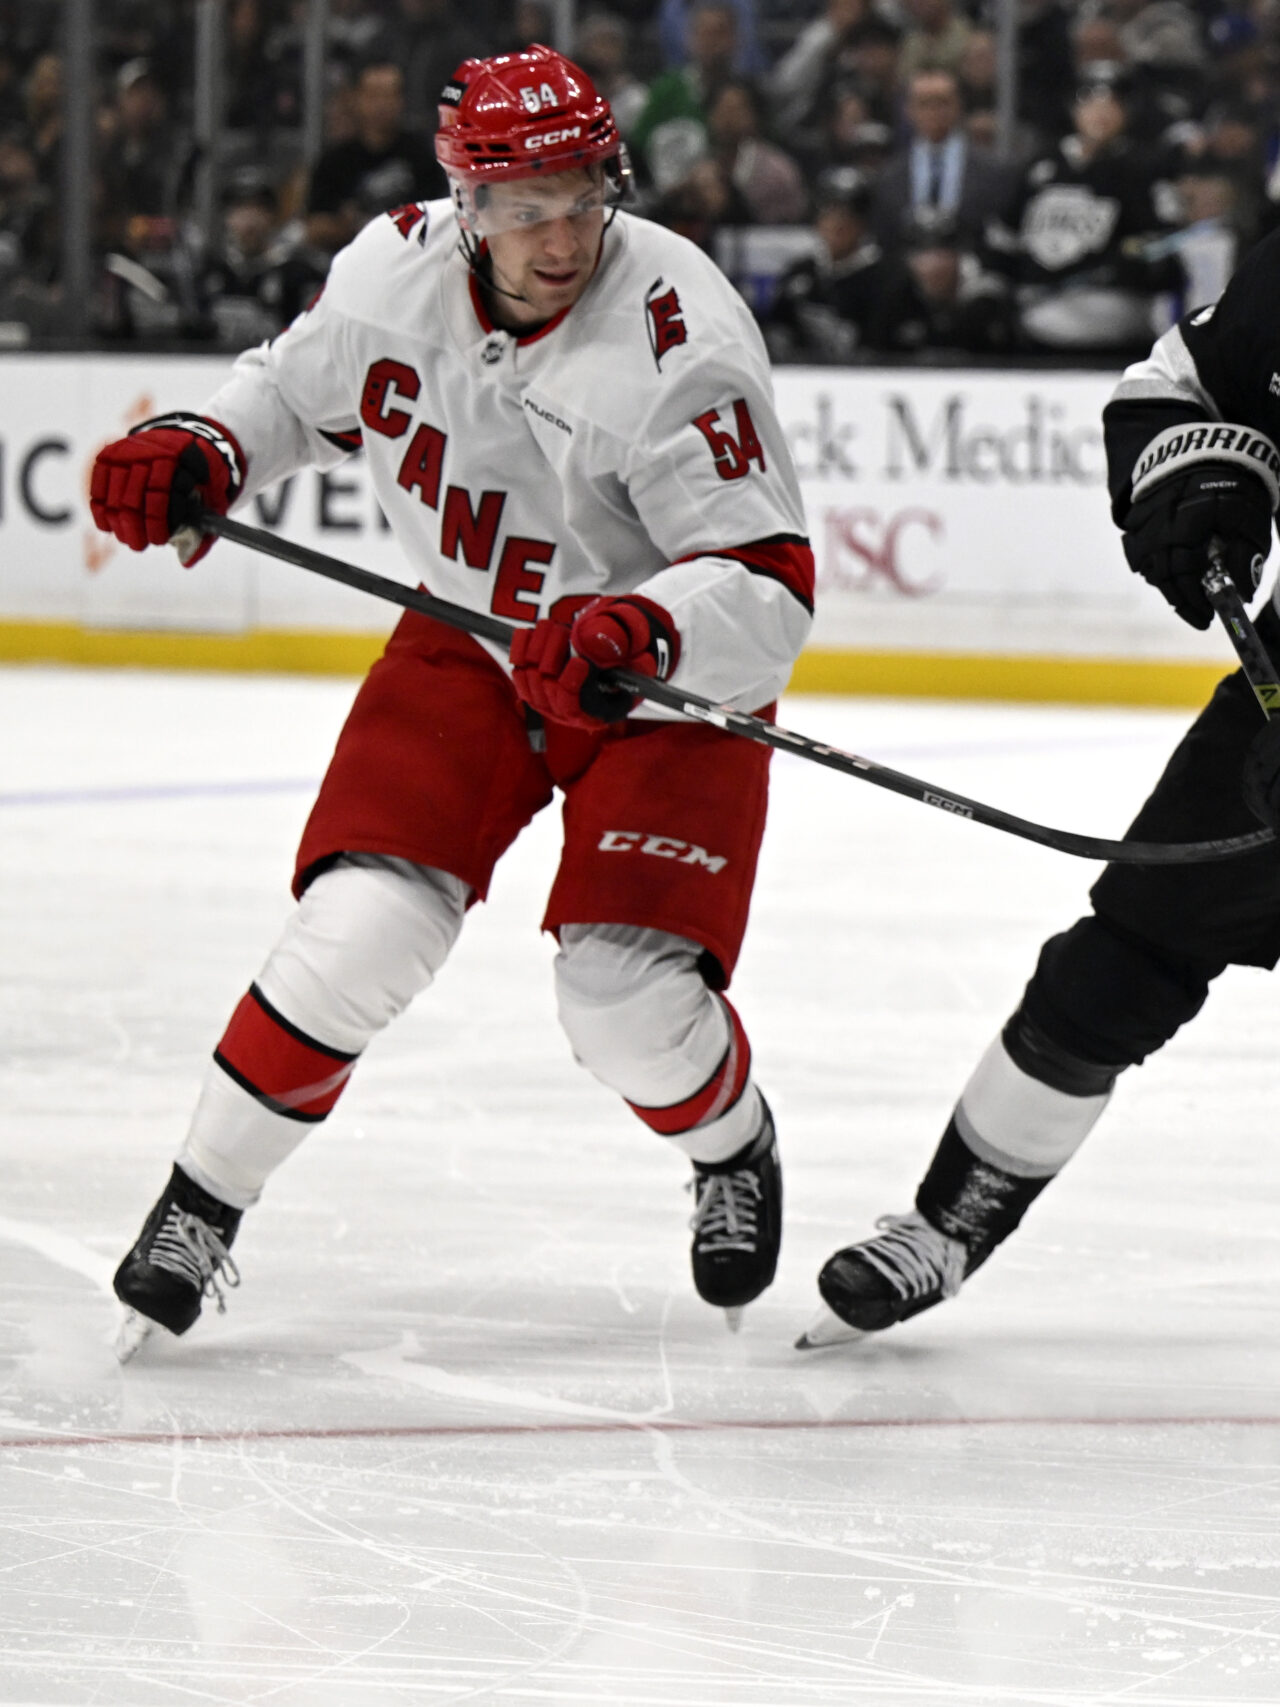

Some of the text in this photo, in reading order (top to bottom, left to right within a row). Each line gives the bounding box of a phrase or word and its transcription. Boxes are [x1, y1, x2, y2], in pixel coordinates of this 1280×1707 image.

[520, 83, 559, 113] 54
[524, 126, 581, 150] CCM
[691, 397, 767, 480] 54
[598, 831, 728, 874] CCM
